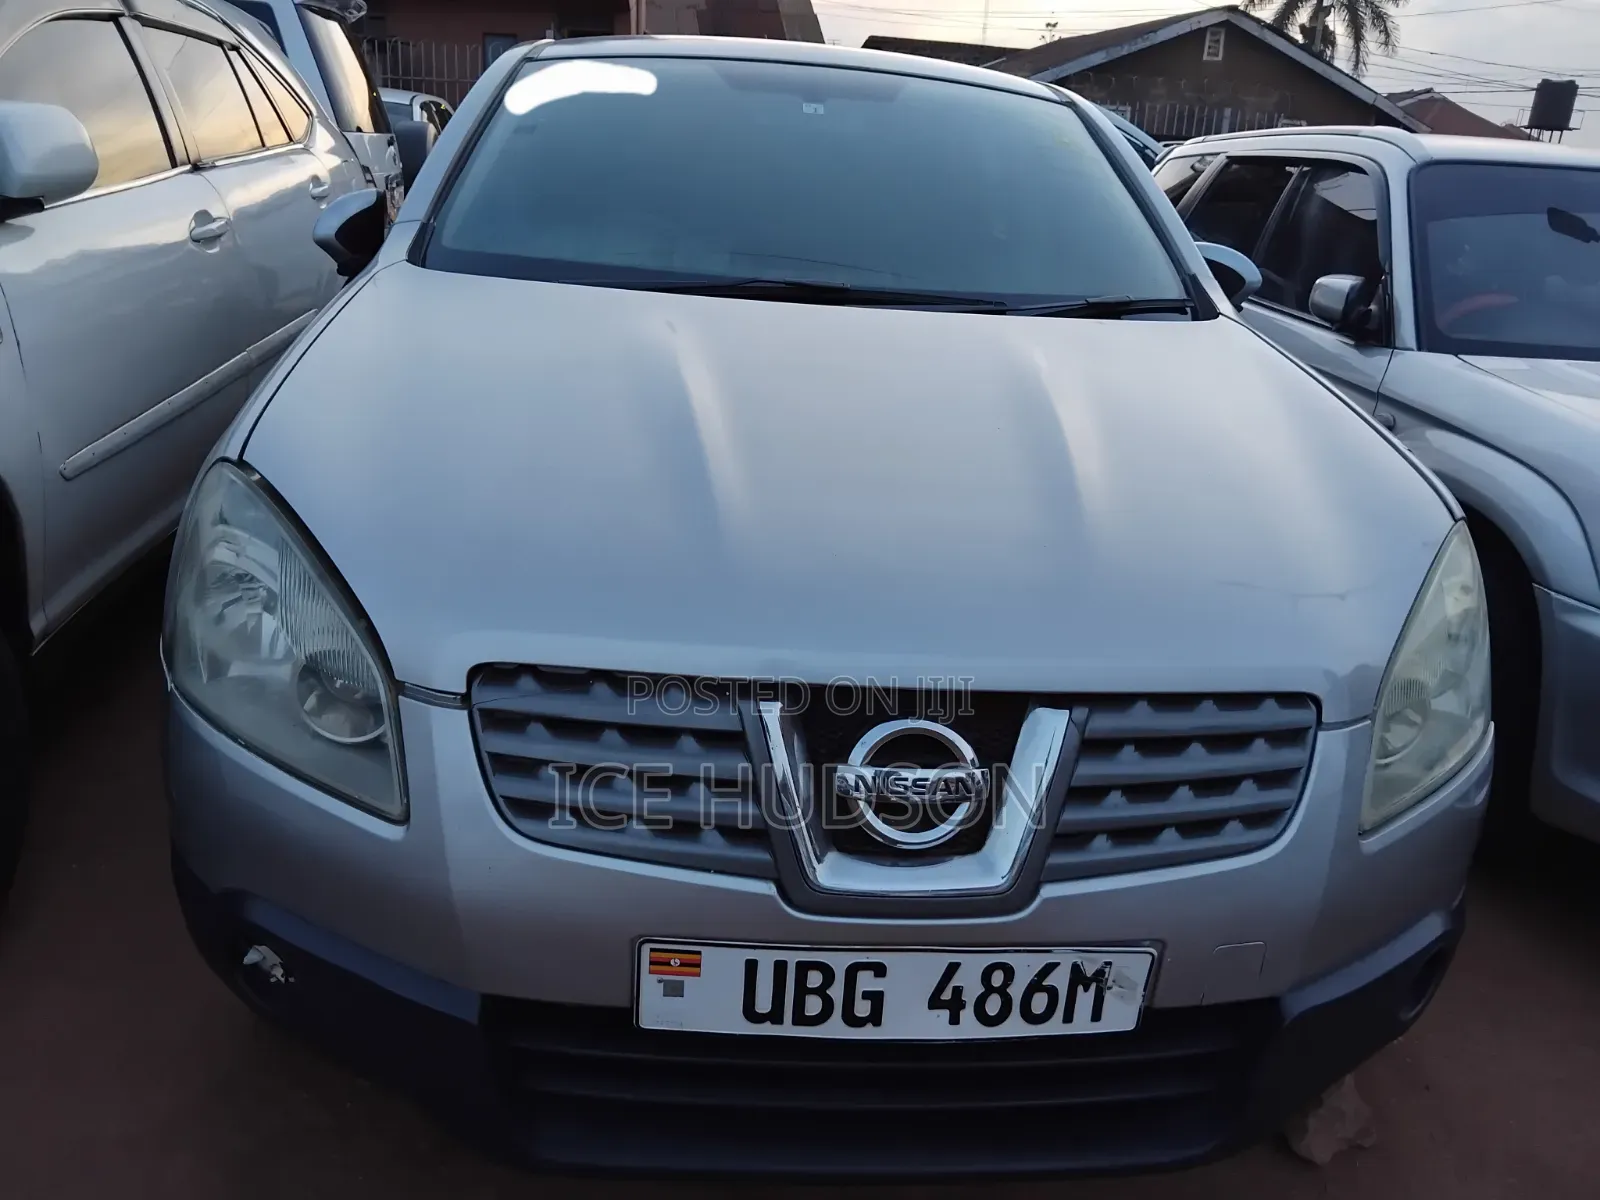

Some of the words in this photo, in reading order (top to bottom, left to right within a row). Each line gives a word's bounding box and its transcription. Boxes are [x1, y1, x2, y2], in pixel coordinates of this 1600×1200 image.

[854, 774, 975, 796] NISSAN
[741, 958, 887, 1028] UBG
[927, 960, 1112, 1027] 486M
